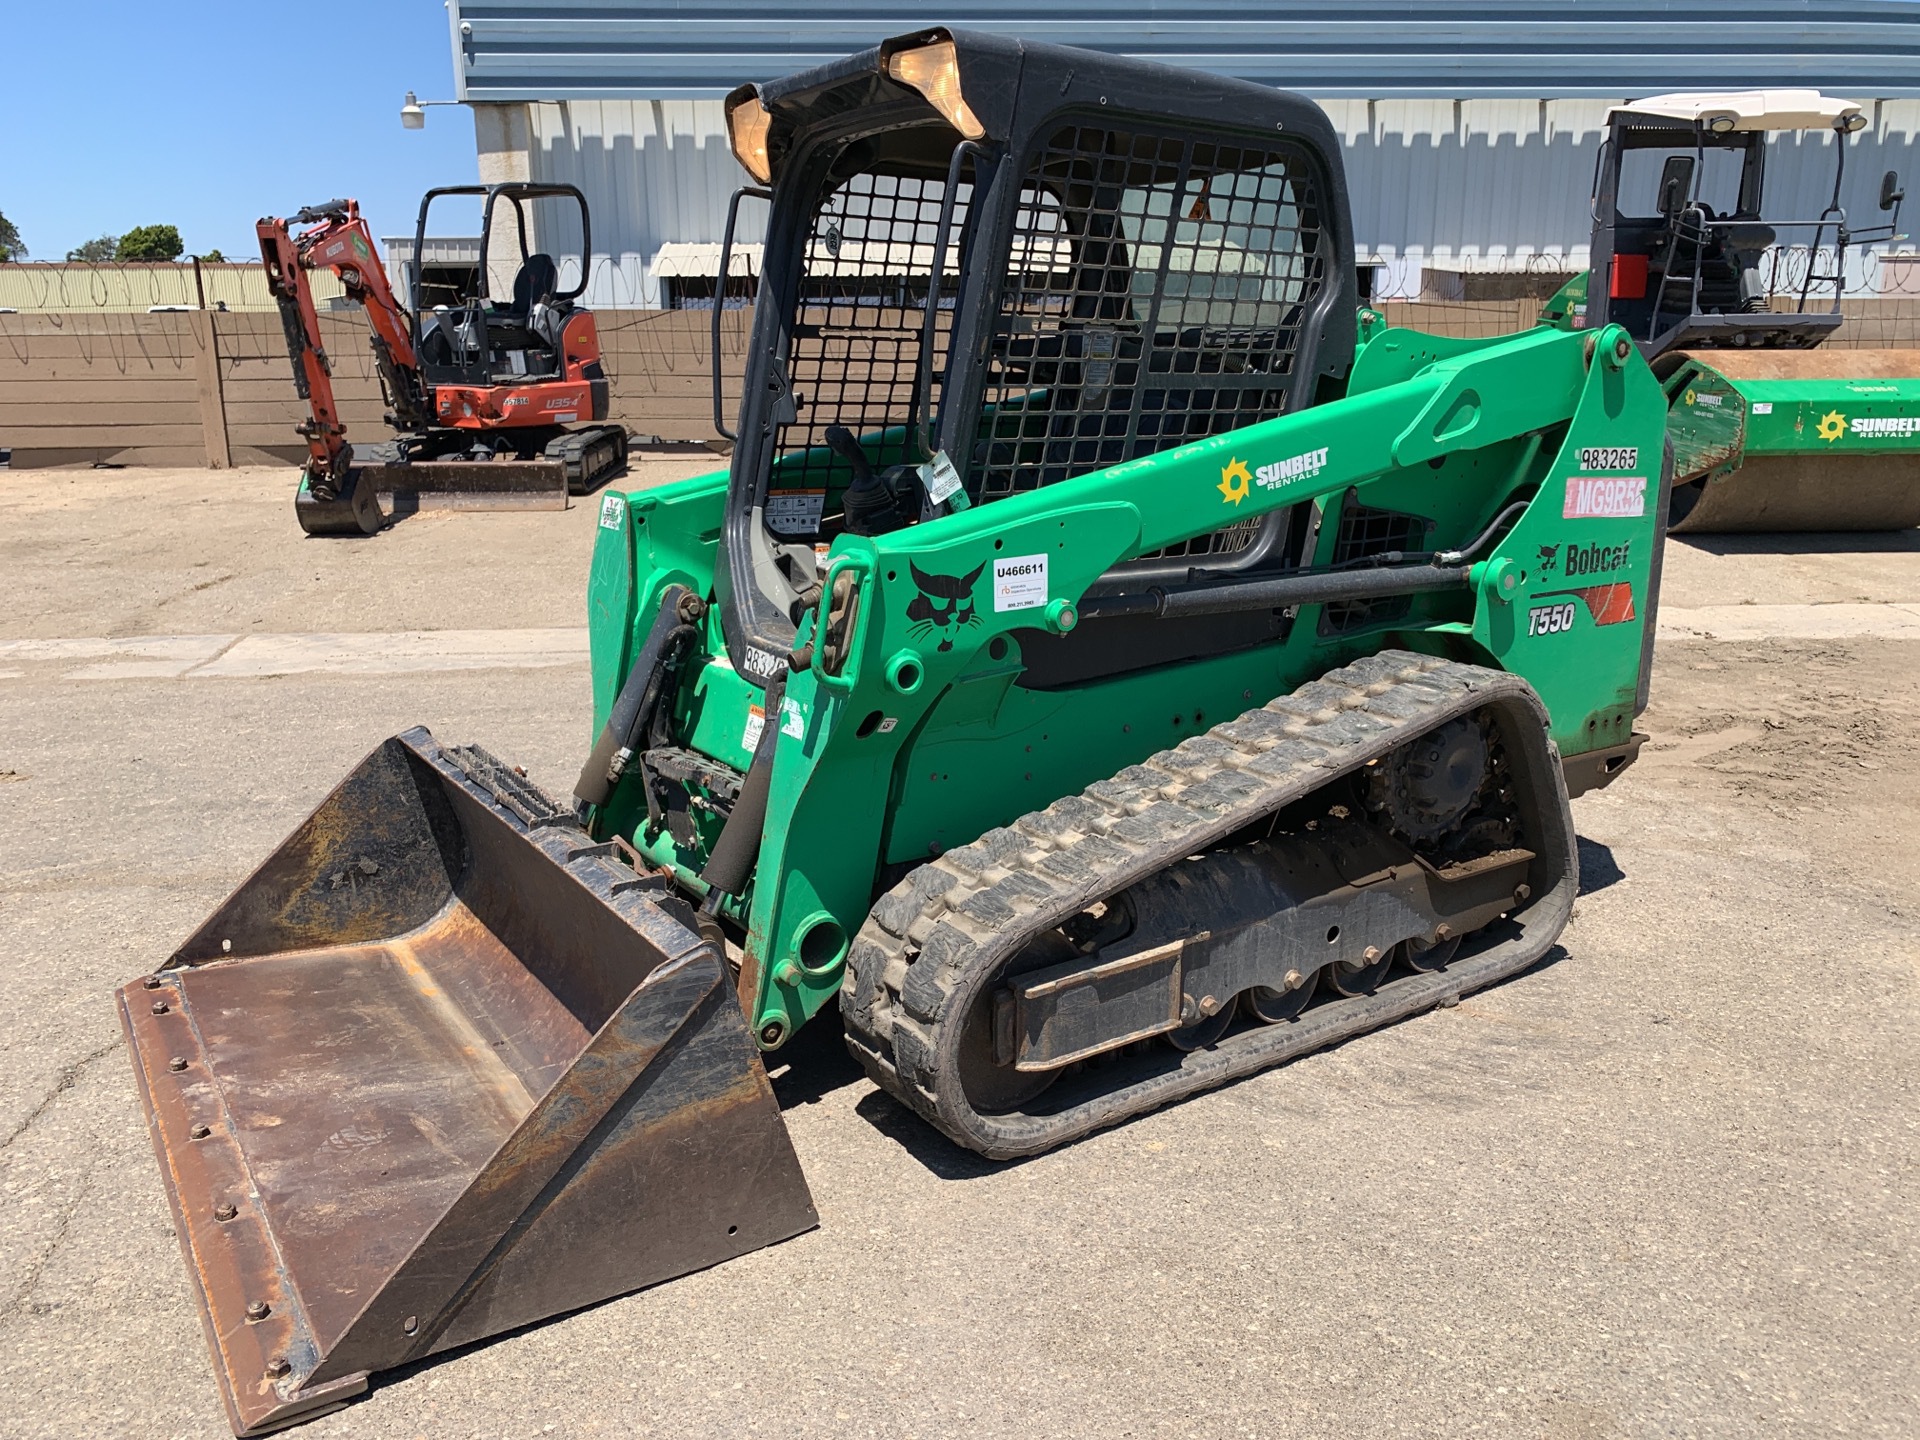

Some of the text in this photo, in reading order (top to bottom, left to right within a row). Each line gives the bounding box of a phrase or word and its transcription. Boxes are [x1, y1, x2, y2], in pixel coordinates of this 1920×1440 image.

[1696, 393, 1723, 405] SUNBELT
[1255, 447, 1329, 487] SUNBELT
[1582, 449, 1637, 470] 983265
[1267, 468, 1320, 491] RENTALS
[1565, 540, 1630, 576] Bobcat
[997, 563, 1043, 578] U466611
[1528, 602, 1575, 637] T550
